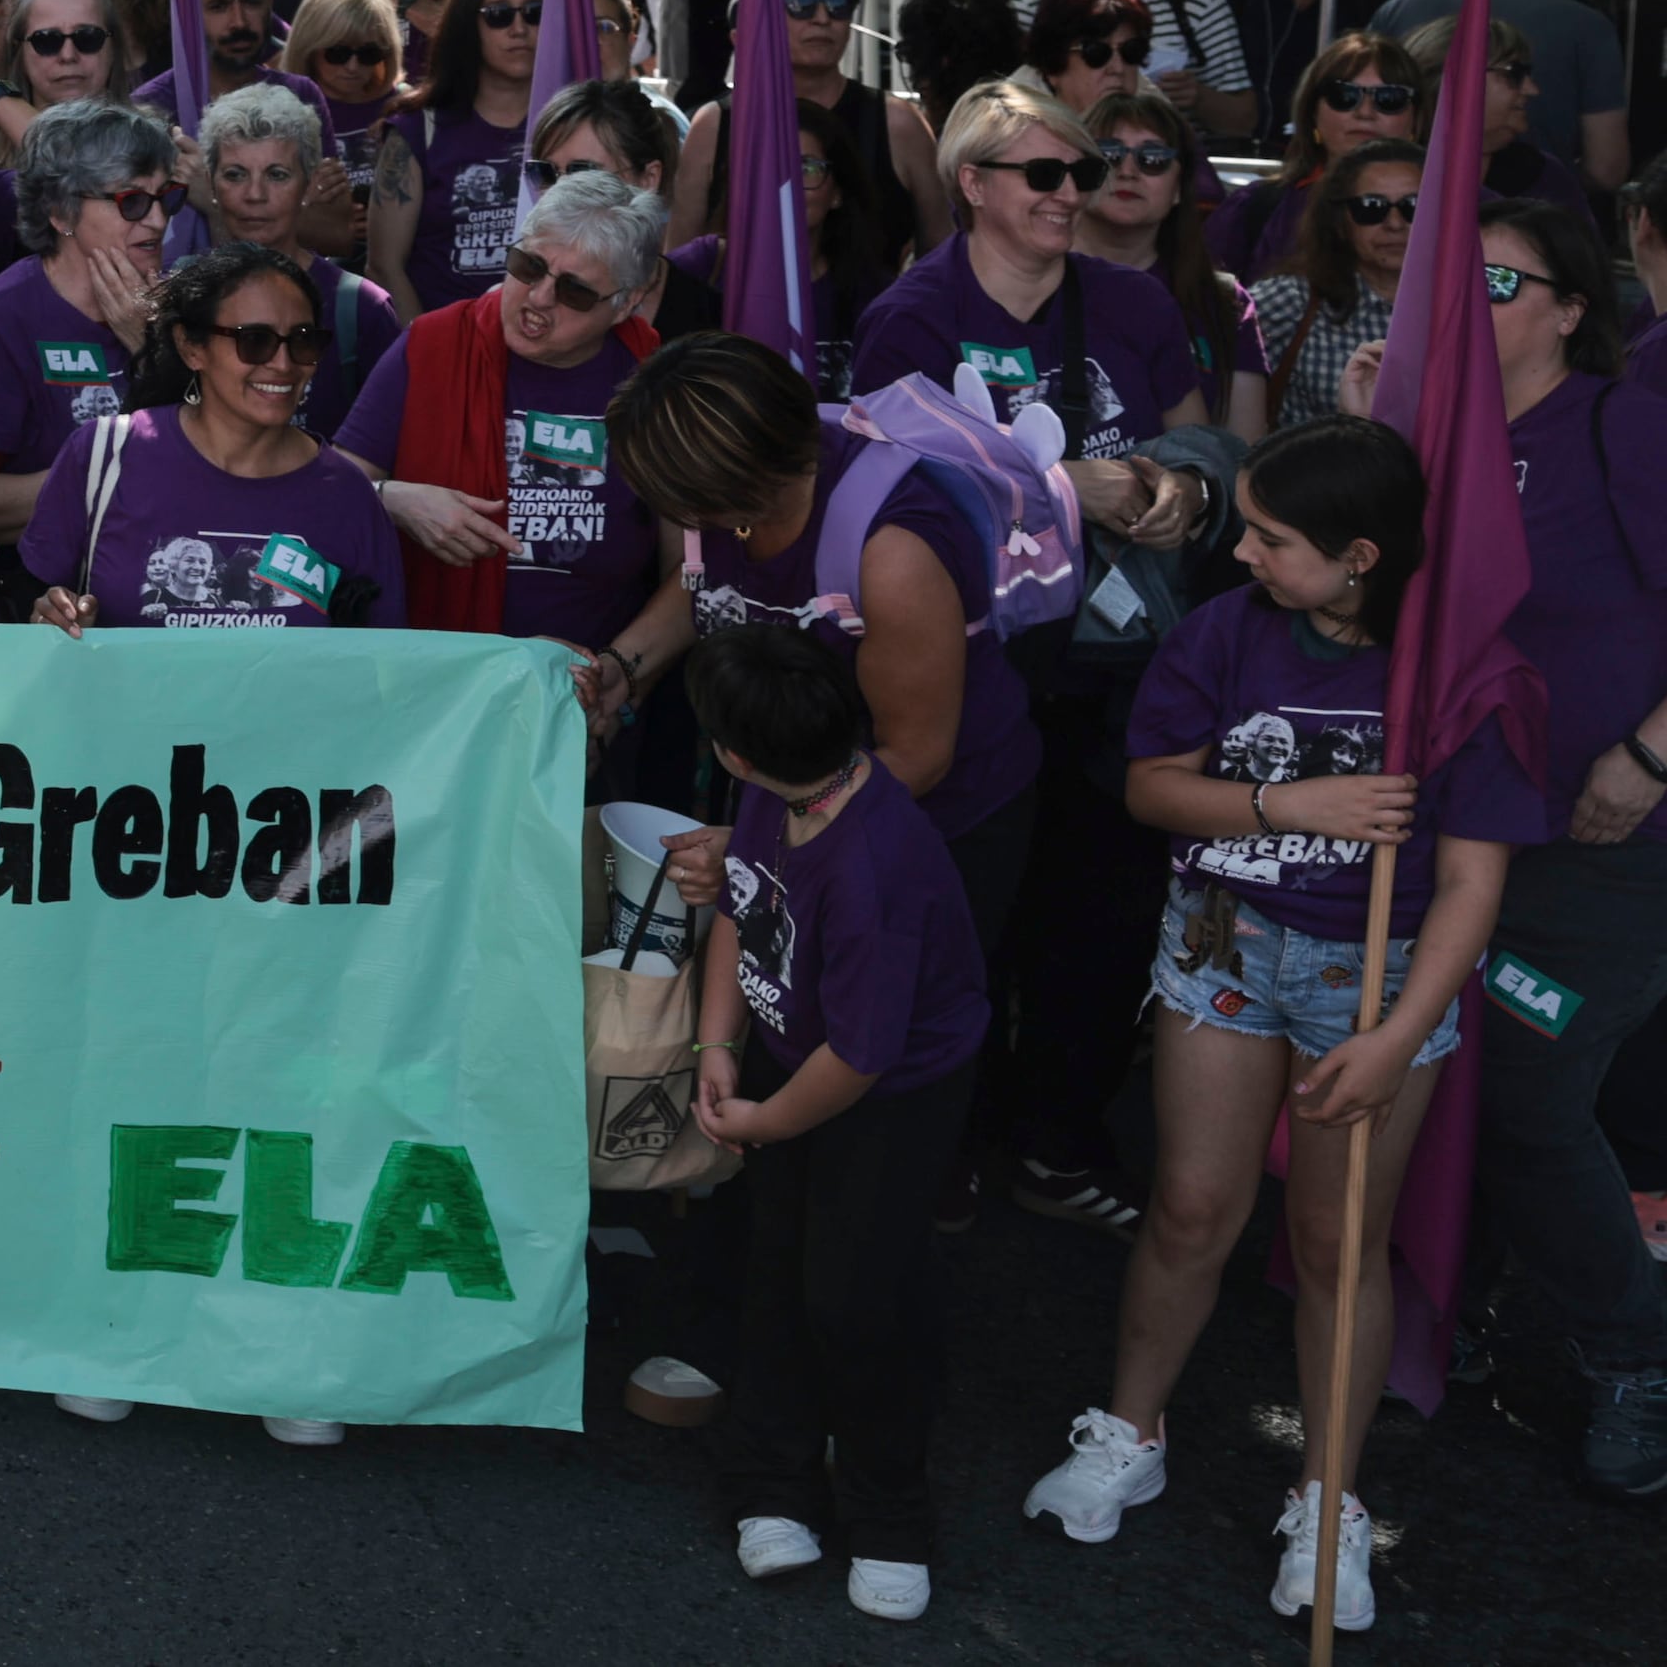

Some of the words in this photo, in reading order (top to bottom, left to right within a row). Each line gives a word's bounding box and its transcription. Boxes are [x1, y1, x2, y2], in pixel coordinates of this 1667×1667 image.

[455, 218, 516, 233] ERRESIDE
[468, 207, 516, 223] GIPUZK
[454, 229, 515, 249] GREB
[44, 349, 100, 373] ELA
[969, 349, 1026, 376] ELA
[532, 420, 594, 455] ELA
[507, 487, 593, 503] UZKOAKO
[507, 502, 607, 517] SIDENTZIAK
[507, 516, 606, 542] EBAN!
[269, 543, 325, 595] ELA
[164, 613, 287, 628] GIPUZKOAKO
[1199, 846, 1283, 884] ELA
[1494, 962, 1563, 1022] ELA
[613, 1132, 668, 1152] ALD
[105, 1123, 517, 1303] ELA
